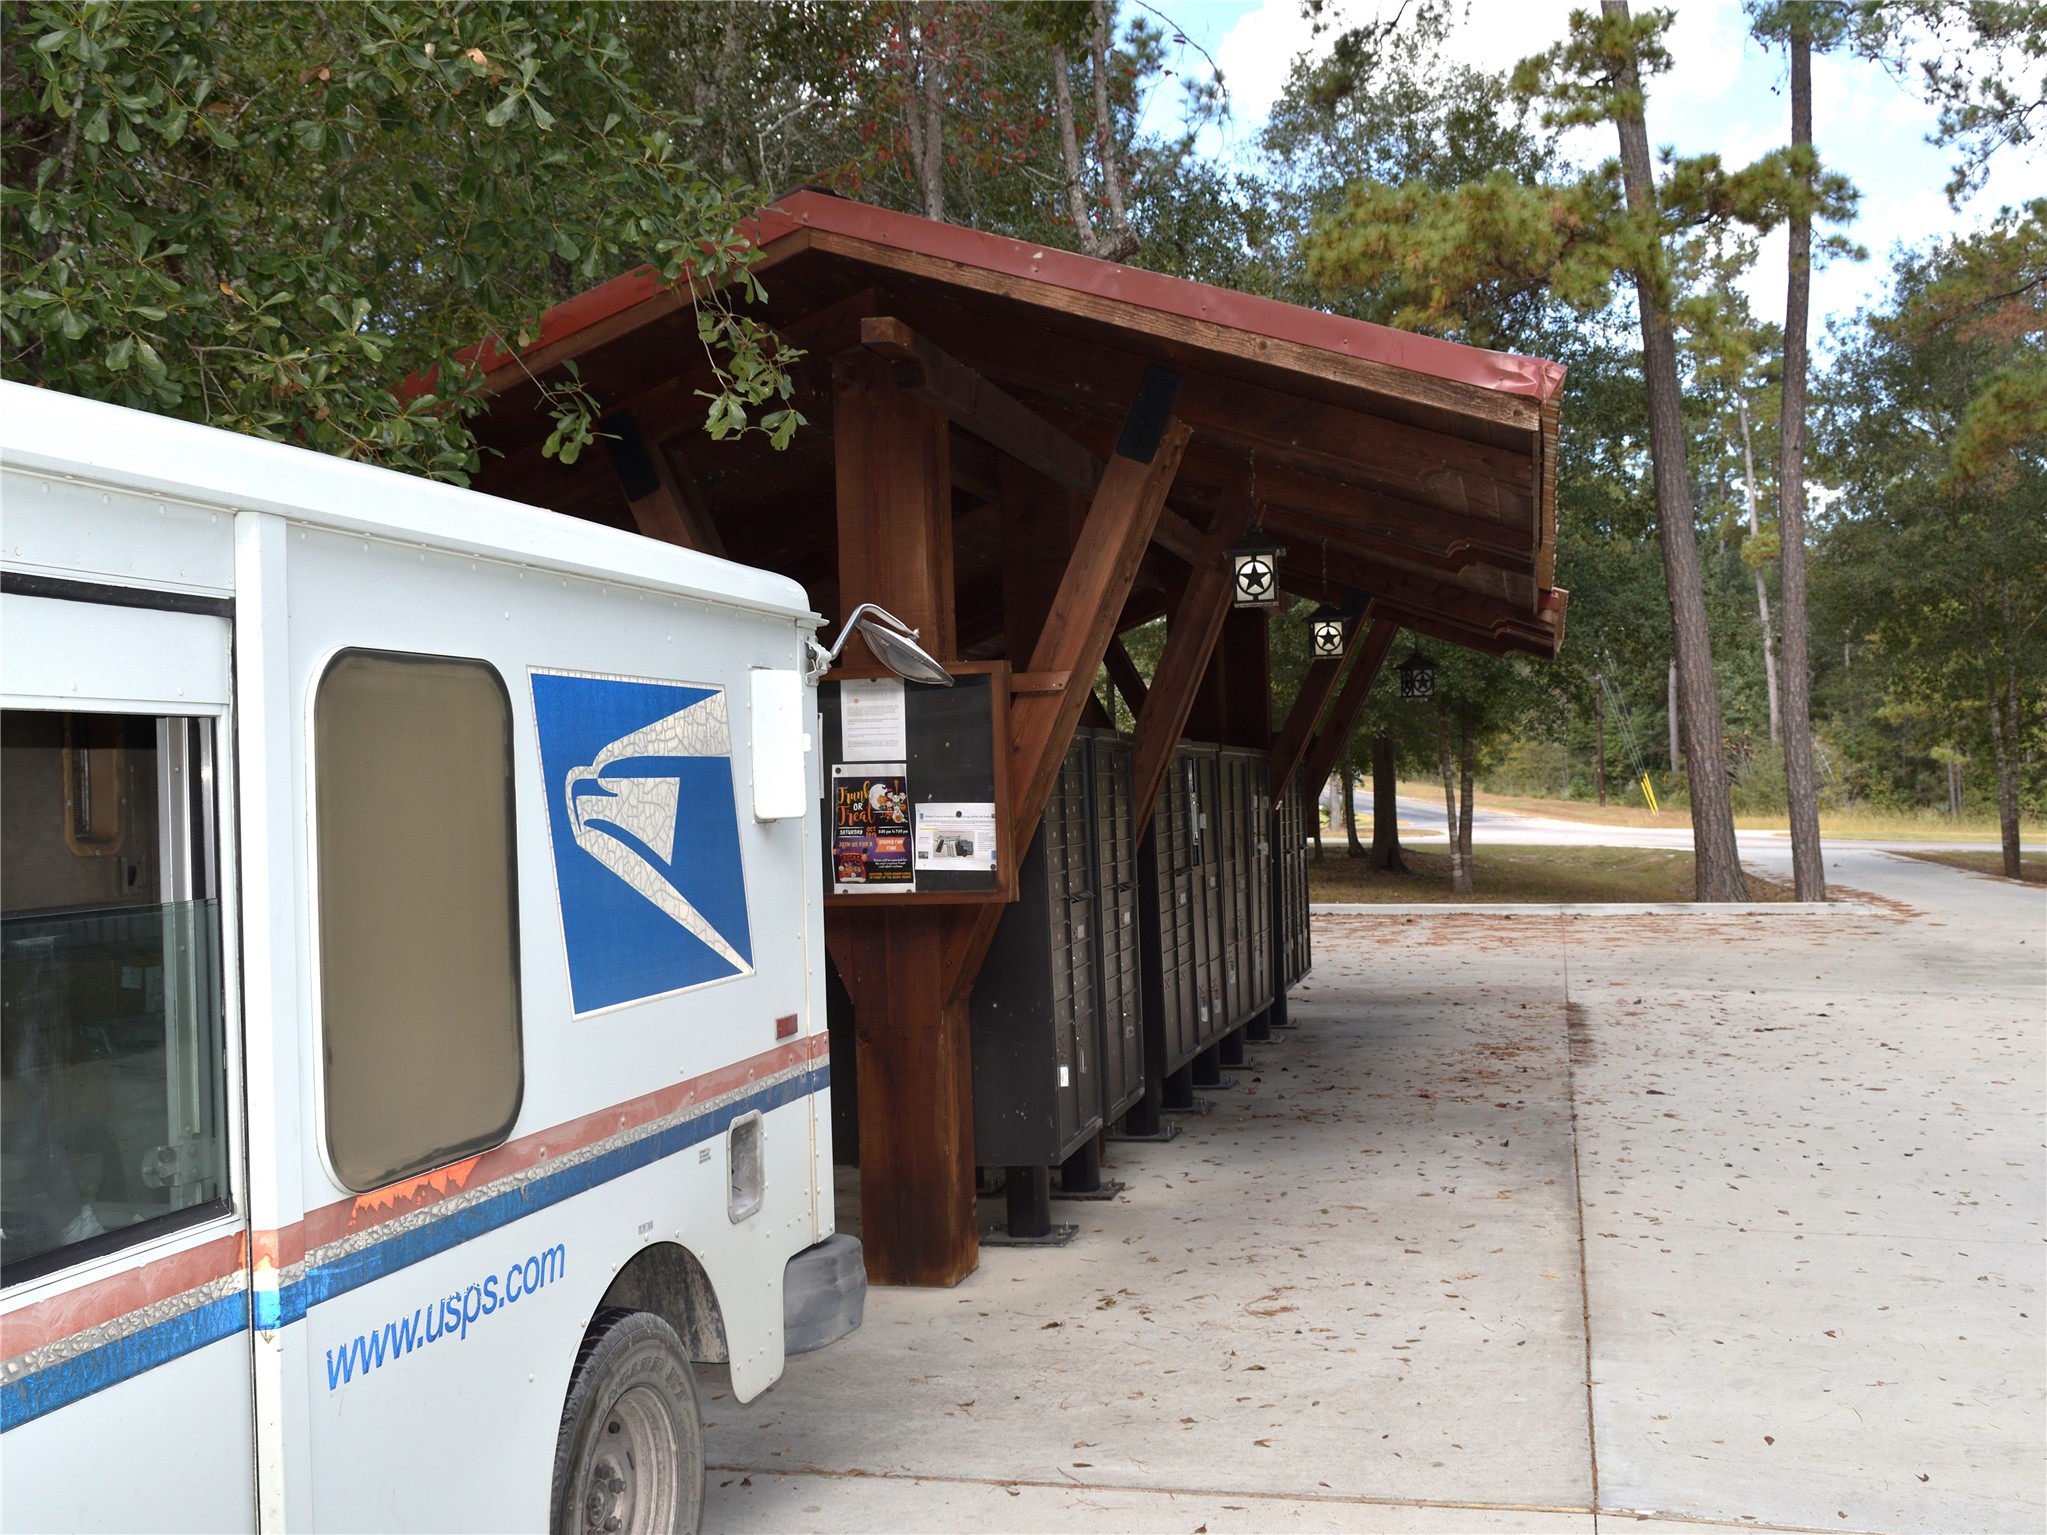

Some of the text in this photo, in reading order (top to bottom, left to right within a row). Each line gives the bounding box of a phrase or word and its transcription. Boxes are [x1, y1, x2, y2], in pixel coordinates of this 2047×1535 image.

[836, 802, 876, 826] Treat
[853, 802, 863, 811] OR
[327, 1243, 566, 1391] www.usps.com
